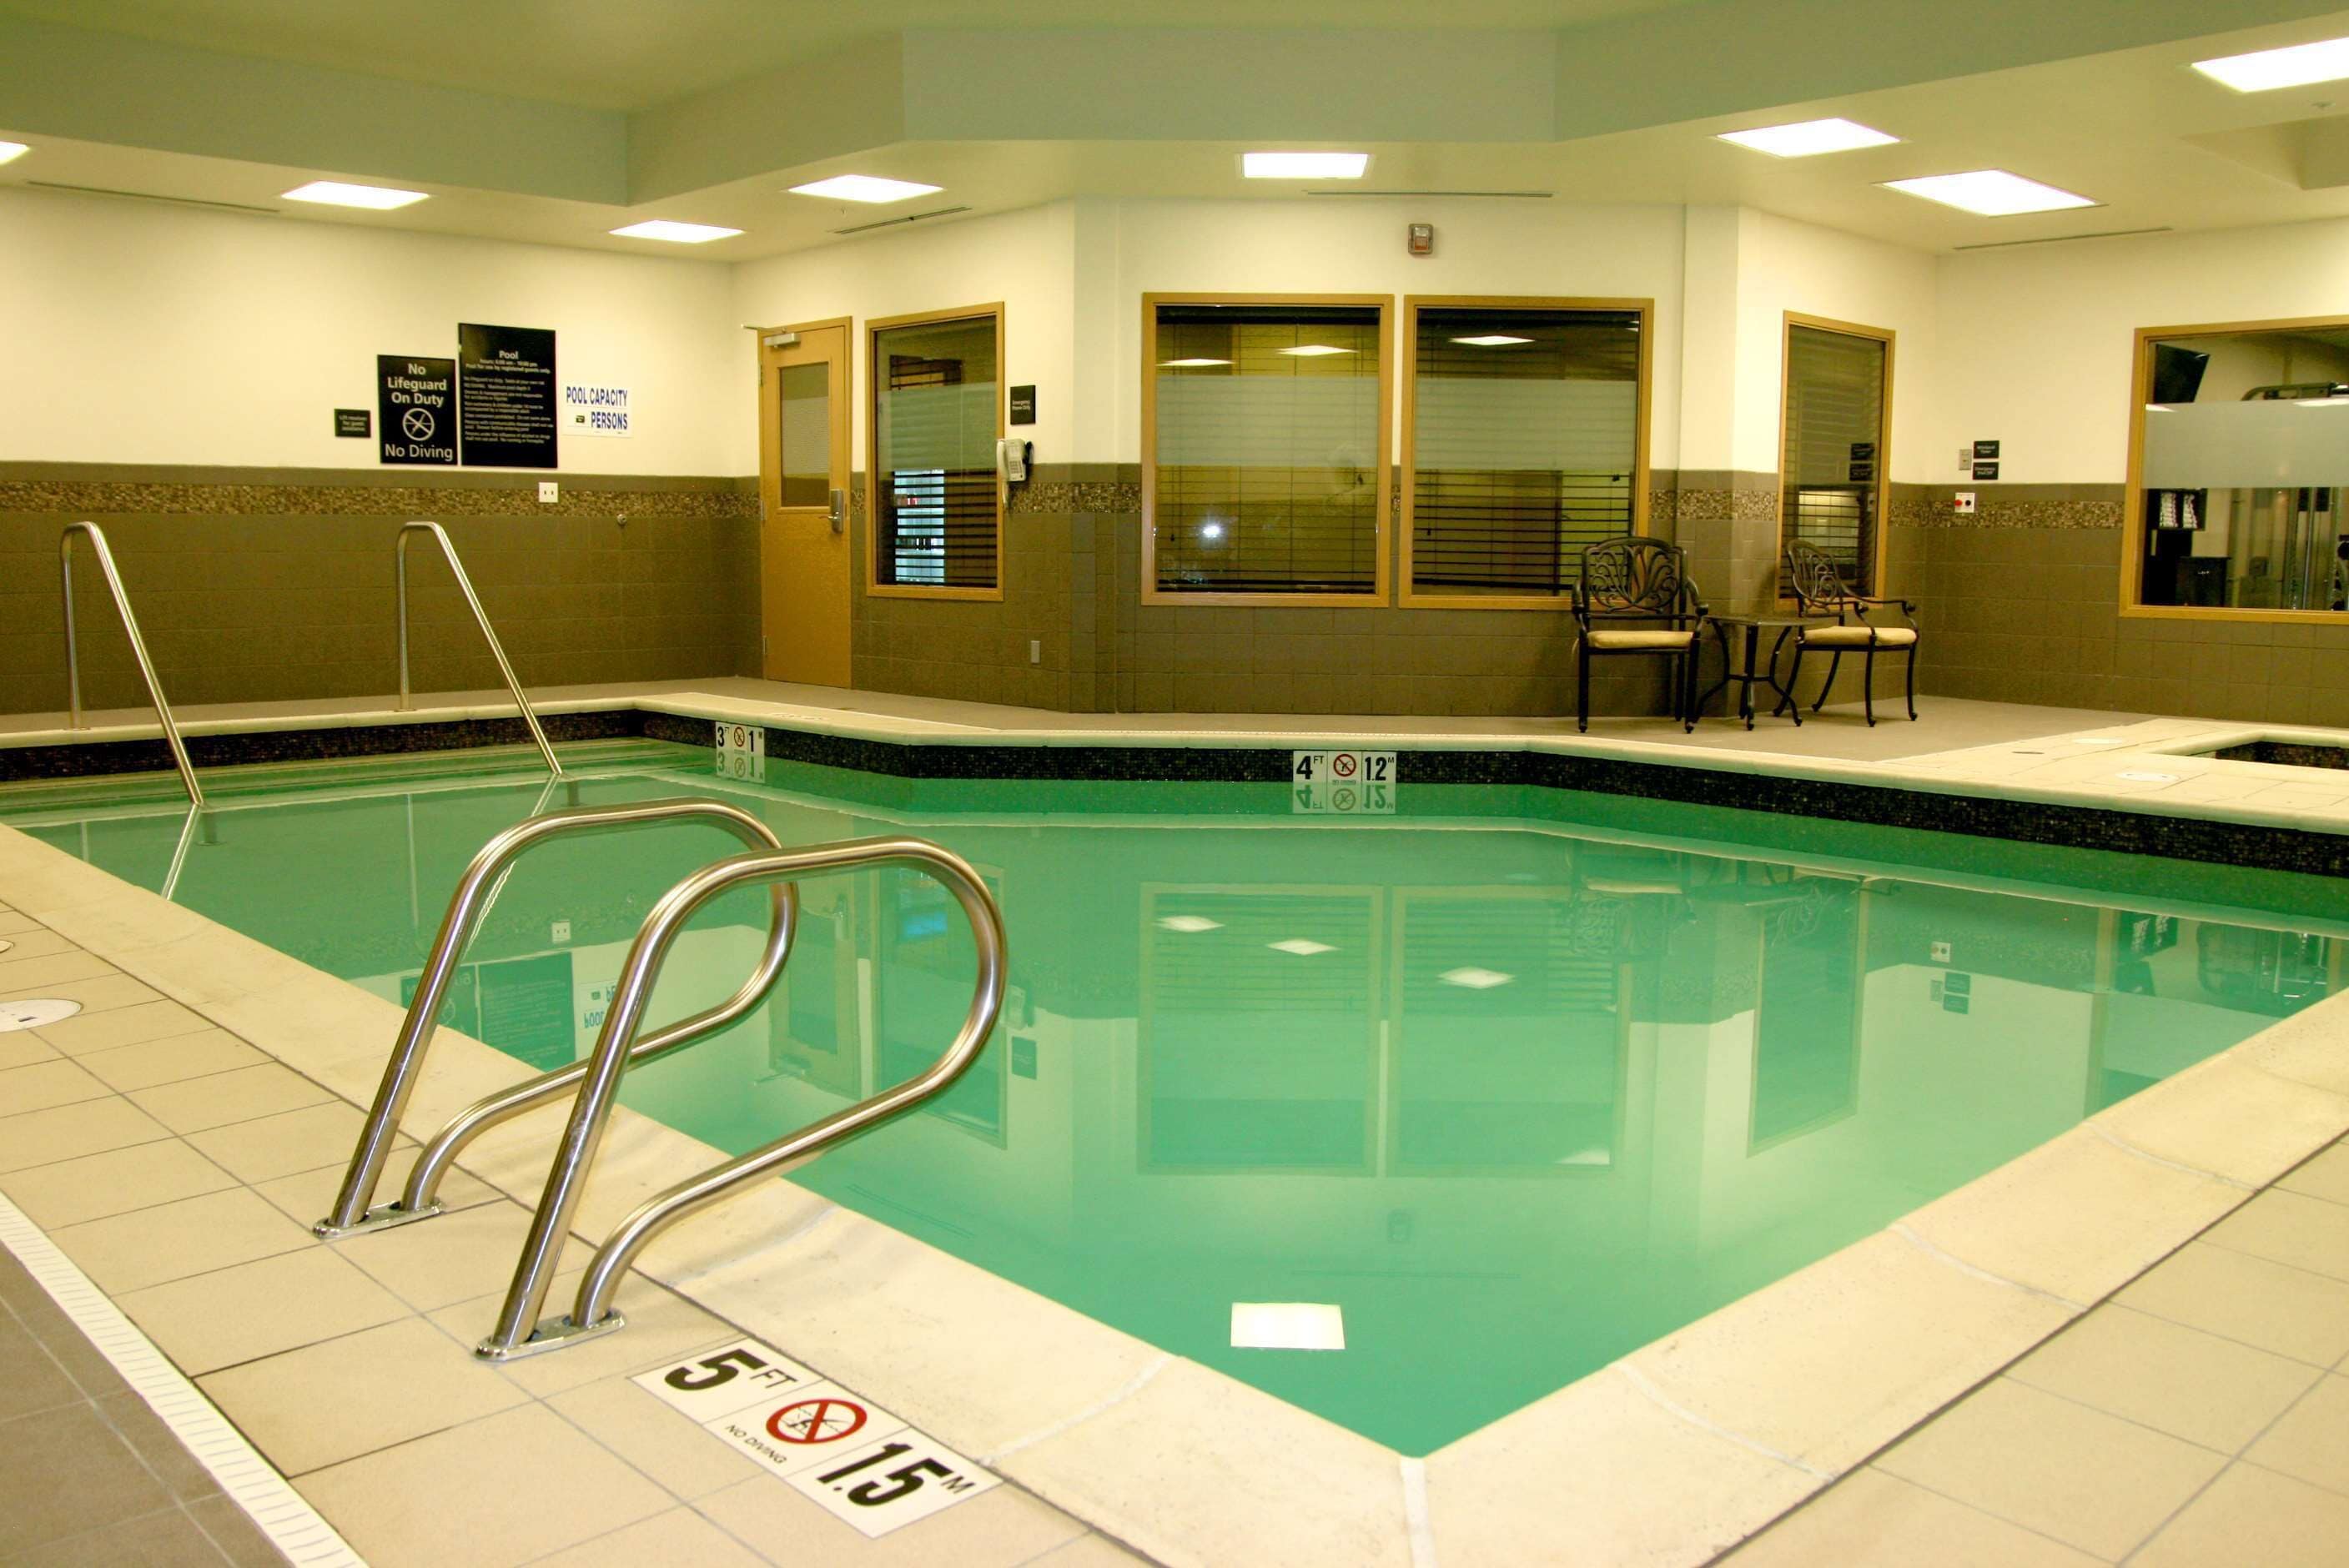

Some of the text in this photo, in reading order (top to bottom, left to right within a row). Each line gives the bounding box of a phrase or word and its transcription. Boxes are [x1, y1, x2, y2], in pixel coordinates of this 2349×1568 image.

[499, 350, 519, 359] Pool
[408, 363, 426, 374] No
[387, 376, 447, 392] Lifeguard
[391, 392, 444, 408] On Duty
[566, 386, 628, 406] POOL CAPACITY
[591, 411, 628, 430] PERSONS
[385, 444, 453, 461] No Diving
[717, 726, 725, 747] 3
[749, 730, 754, 752] 1
[1295, 756, 1325, 780] 4 FT
[1365, 756, 1386, 781] 1.2
[664, 1348, 799, 1391] 5 FT
[725, 1425, 787, 1464] NO DIVING
[816, 1443, 976, 1507] 1.5 M
